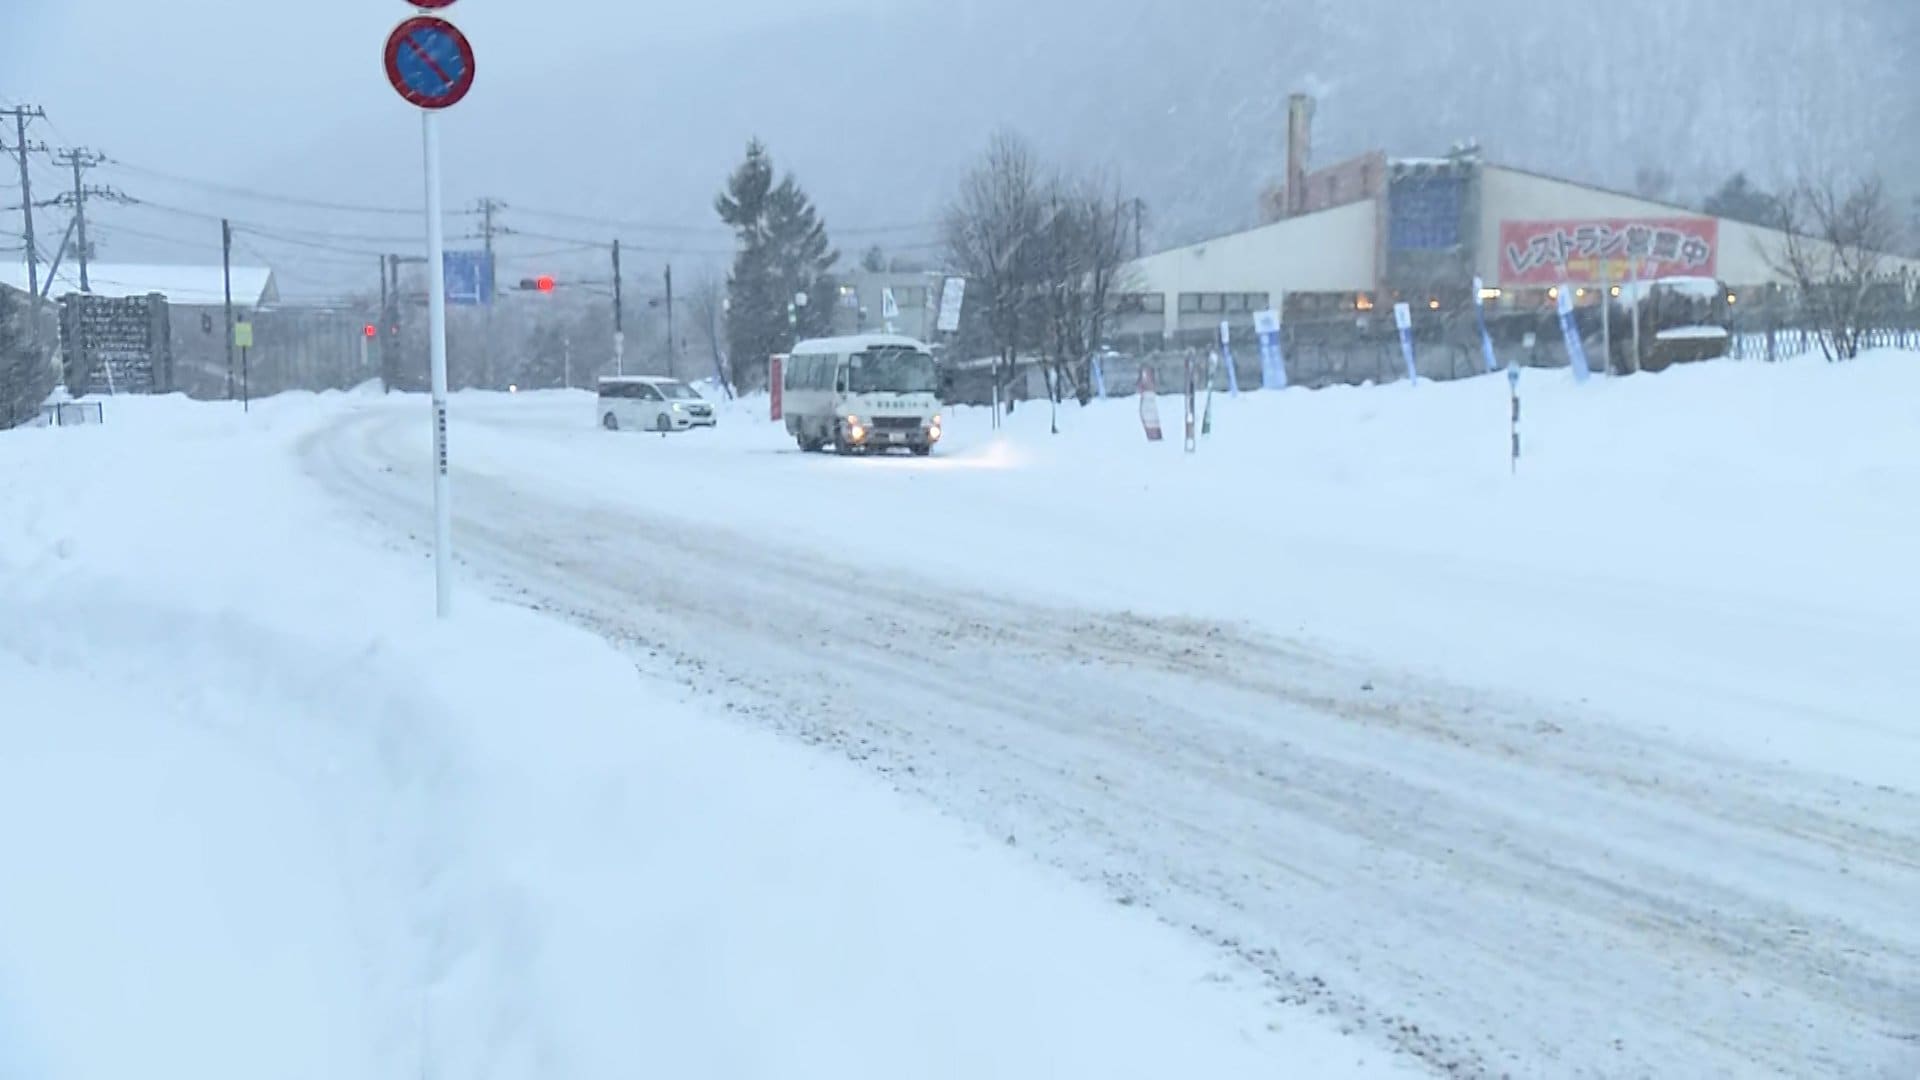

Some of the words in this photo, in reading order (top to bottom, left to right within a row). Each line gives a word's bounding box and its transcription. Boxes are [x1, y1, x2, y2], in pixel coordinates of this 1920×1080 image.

[1507, 225, 1710, 274] レストラン営業中
